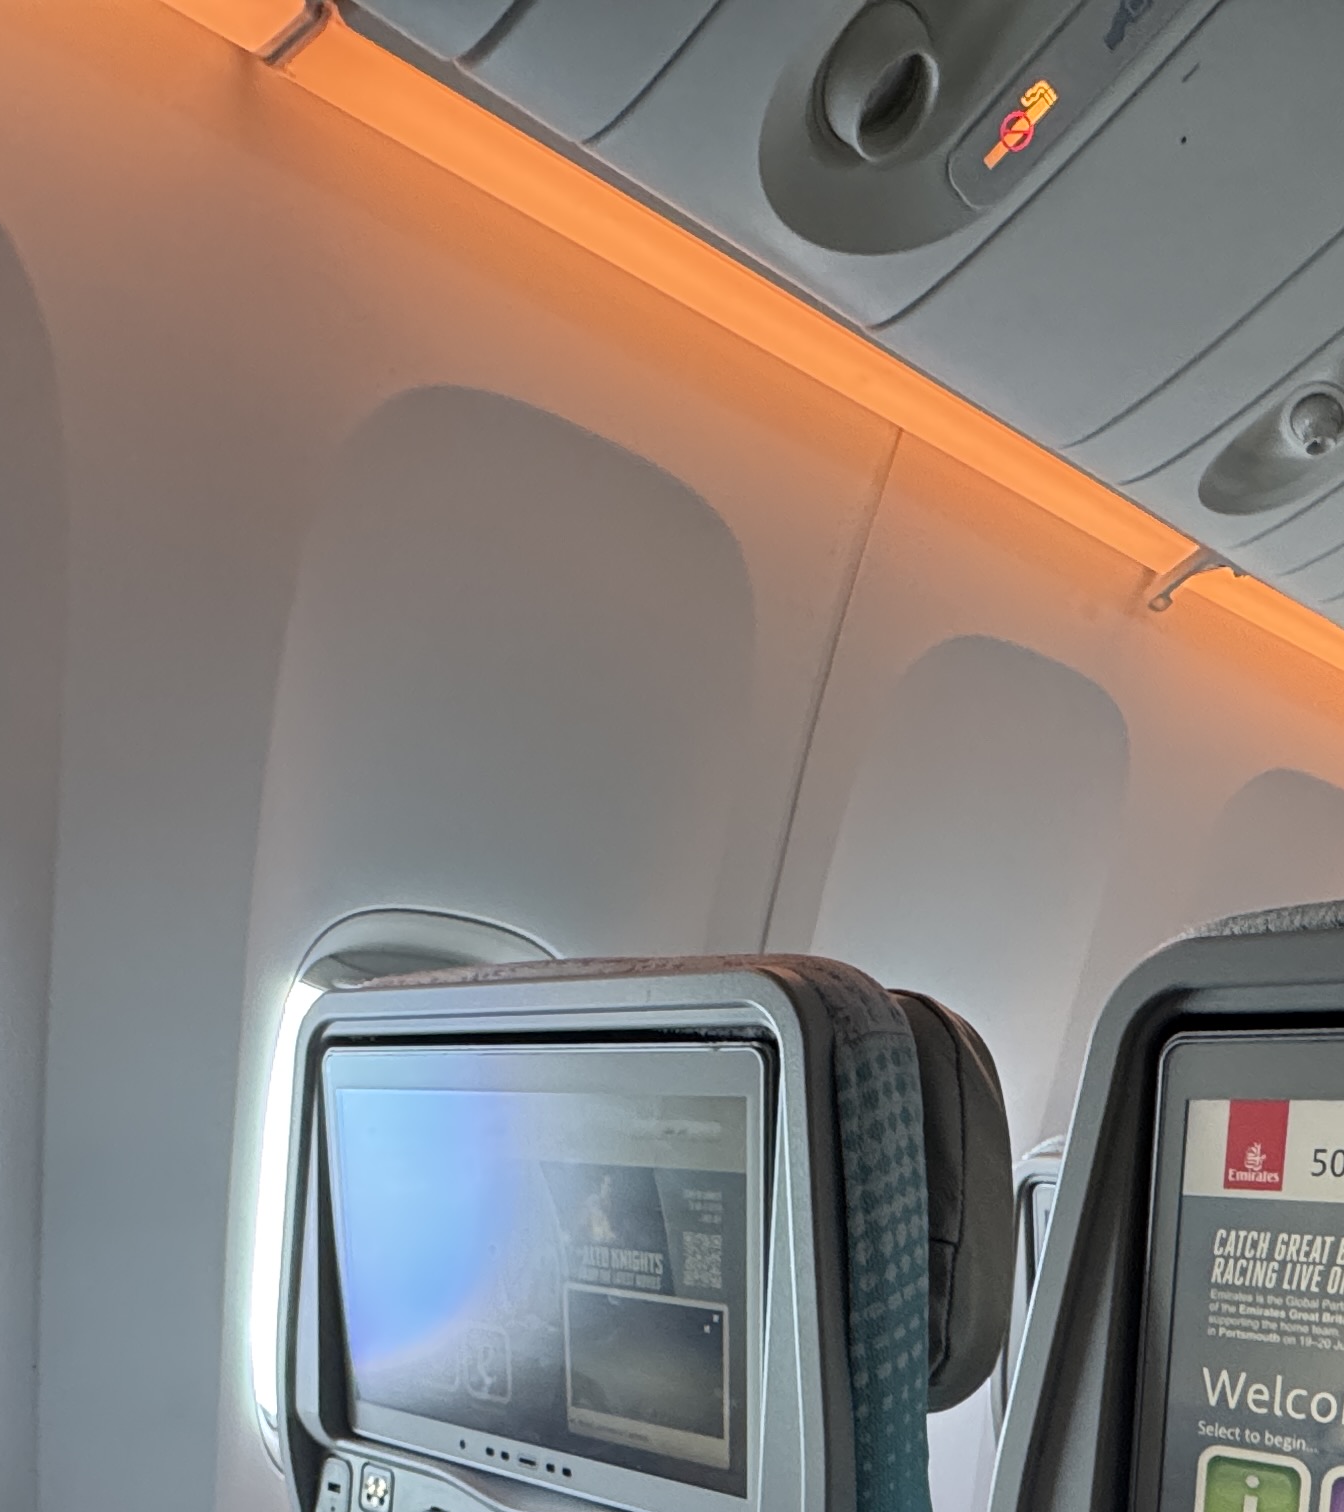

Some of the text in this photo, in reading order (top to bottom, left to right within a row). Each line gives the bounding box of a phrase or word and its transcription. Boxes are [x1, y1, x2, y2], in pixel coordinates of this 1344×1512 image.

[1228, 1167, 1280, 1183] Emirates
[1213, 1228, 1271, 1259] CATCH
[1274, 1232, 1335, 1264] GREAT
[610, 1249, 663, 1275] KNIGHTS
[1211, 1257, 1279, 1289] RACING
[1282, 1262, 1327, 1293] LIVE
[1198, 1420, 1241, 1442] Select
[1244, 1428, 1261, 1444] to
